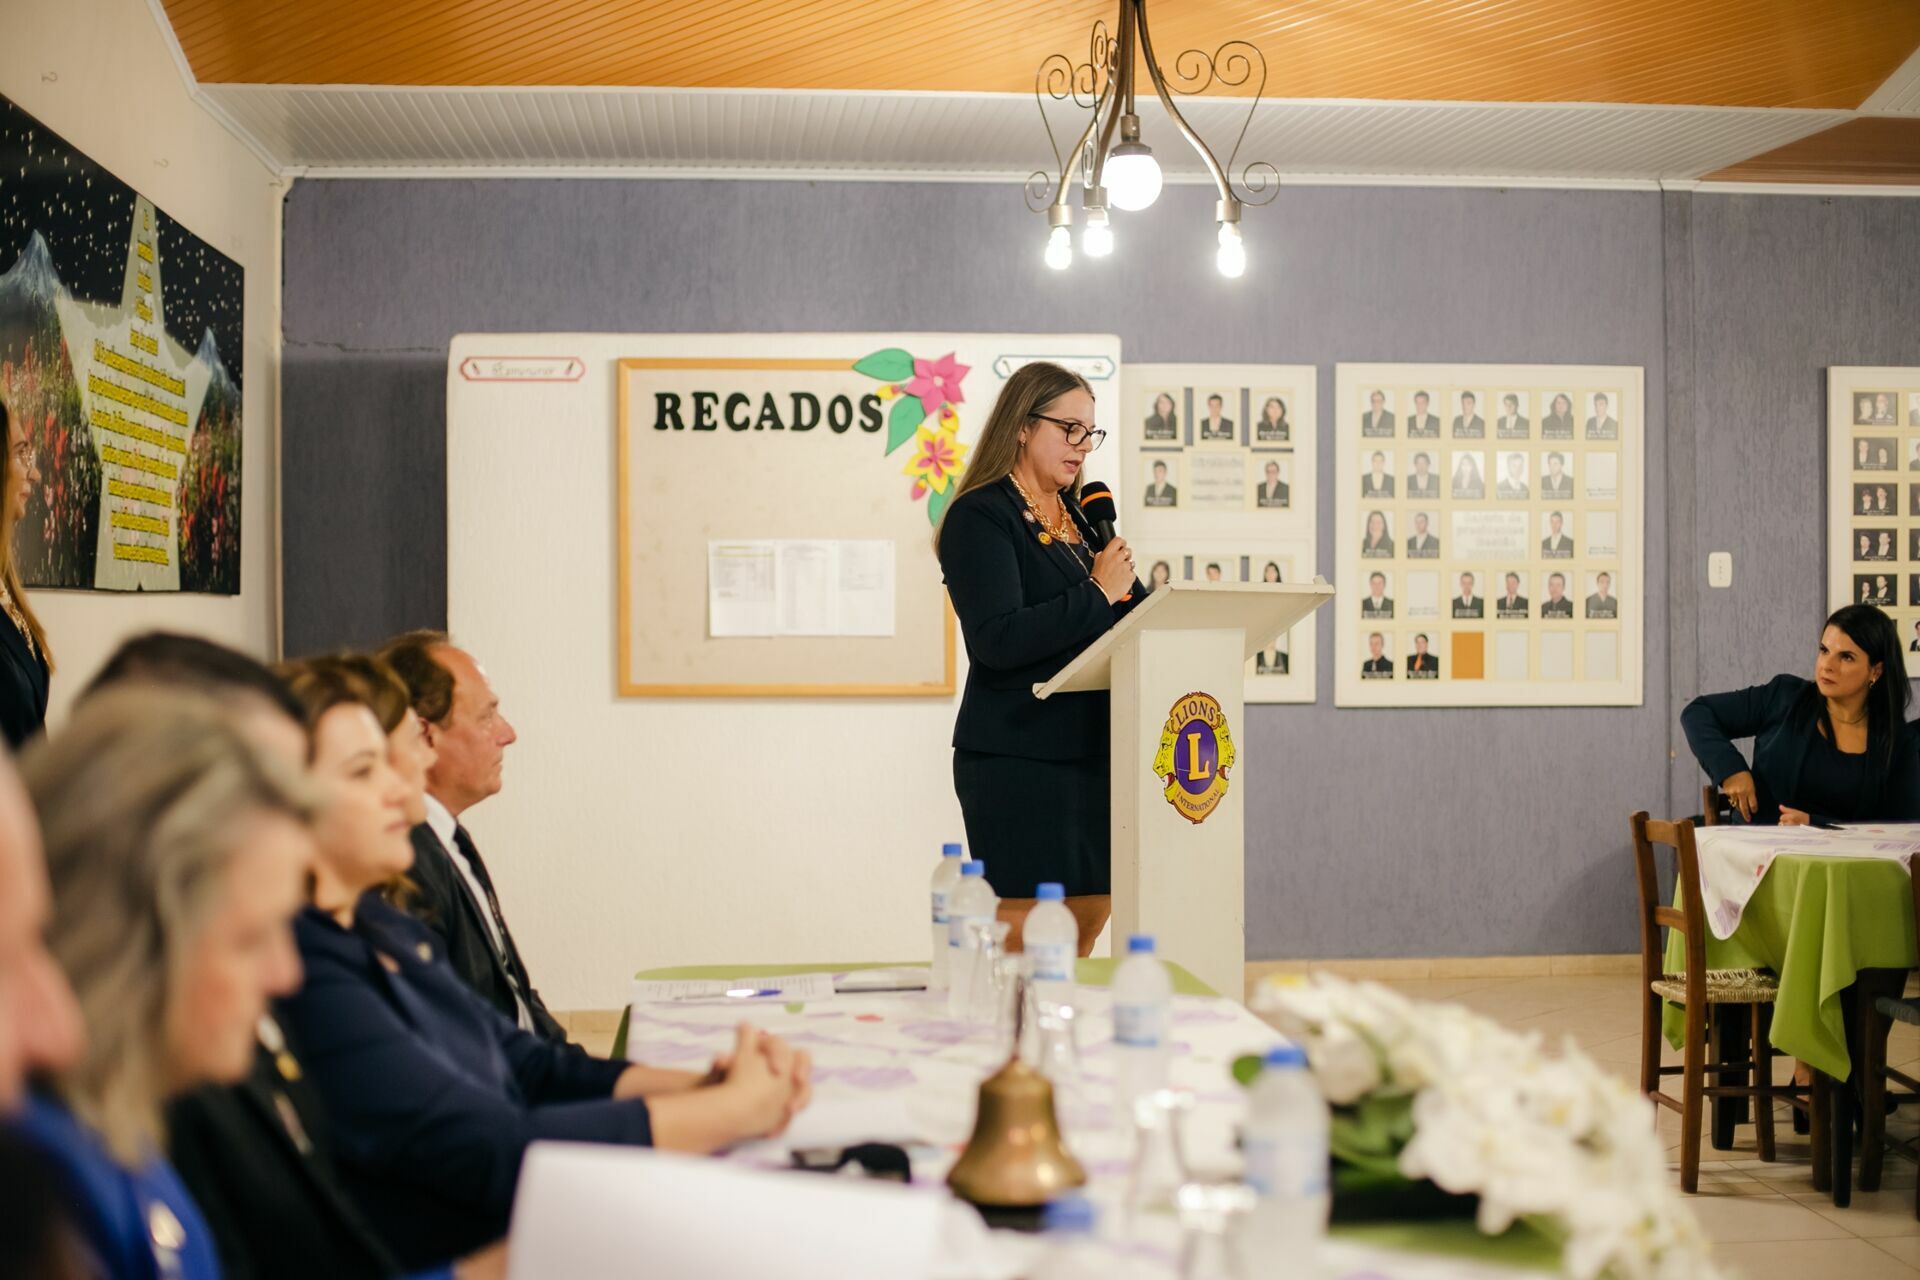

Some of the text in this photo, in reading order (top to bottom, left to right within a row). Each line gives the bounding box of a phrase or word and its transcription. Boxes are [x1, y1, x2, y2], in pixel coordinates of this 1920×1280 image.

[653, 391, 883, 434] RECADOS
[1176, 701, 1215, 725] LIONS
[1188, 733, 1210, 780] L
[1177, 790, 1219, 811] INTERNATIONAL
